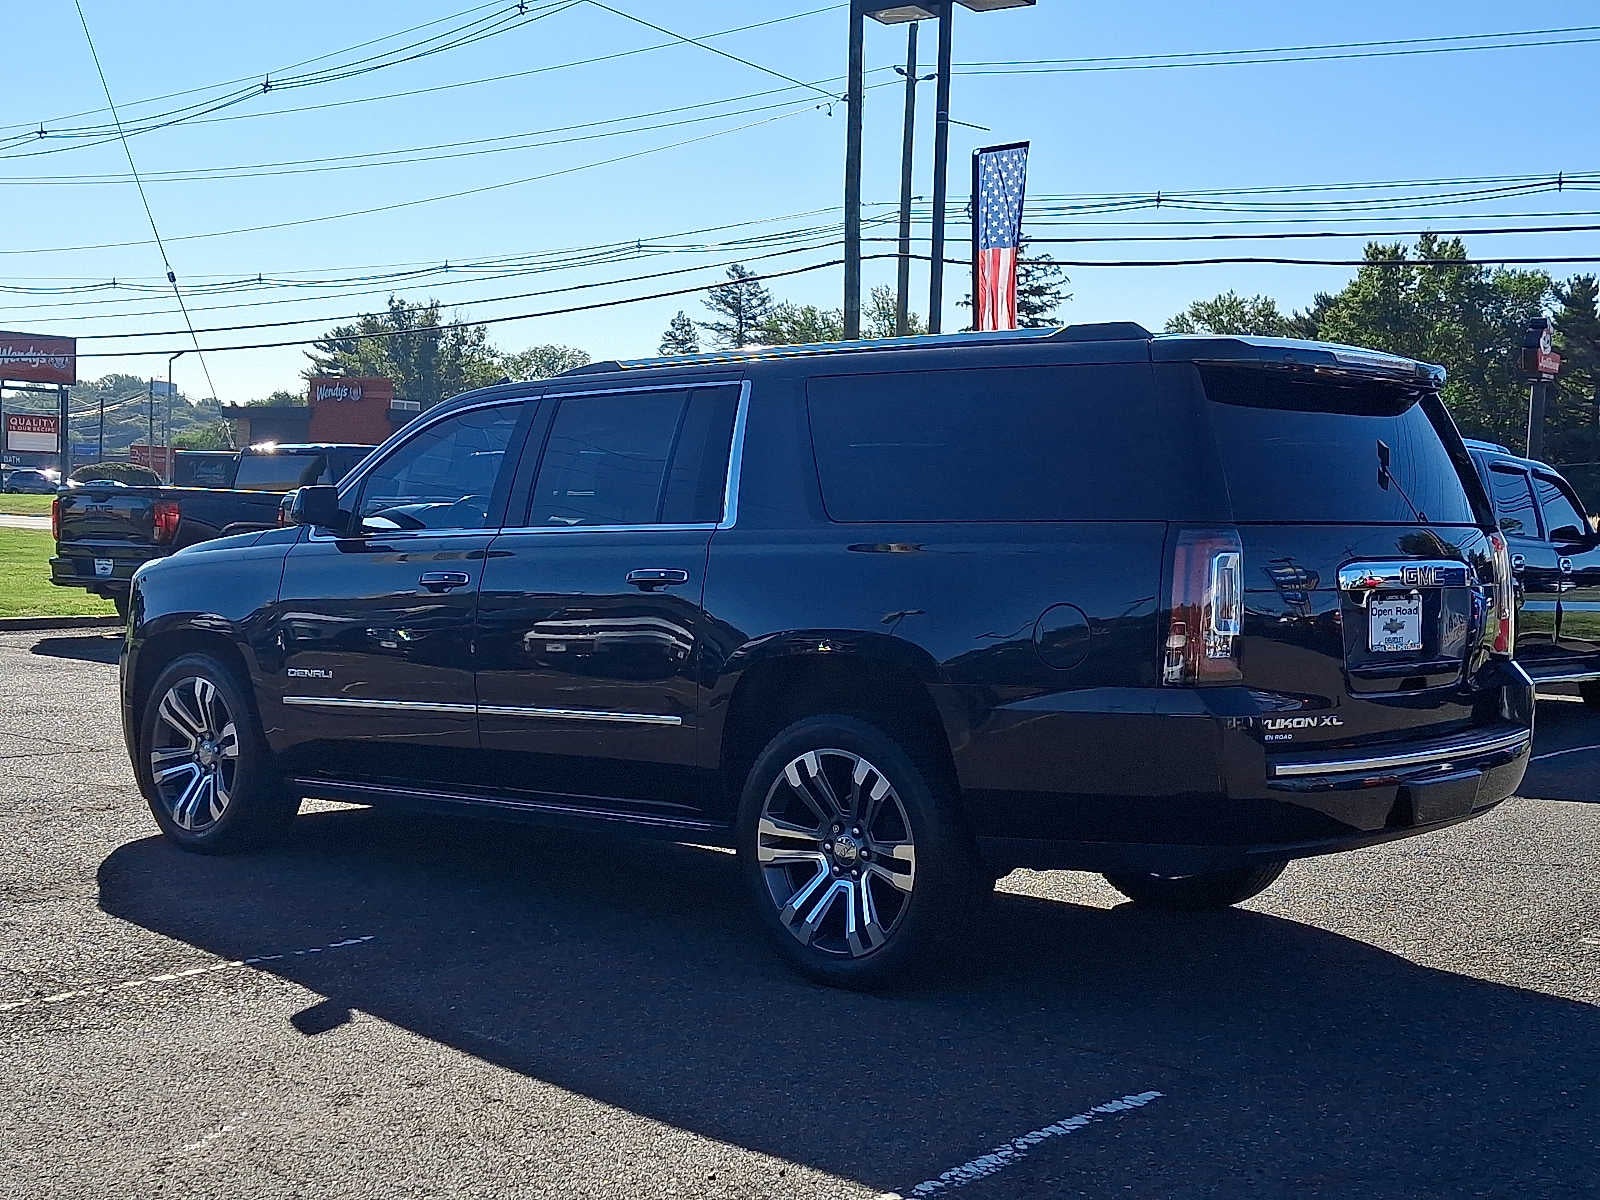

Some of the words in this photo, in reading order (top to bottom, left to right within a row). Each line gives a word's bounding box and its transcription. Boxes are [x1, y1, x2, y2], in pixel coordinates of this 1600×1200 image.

[316, 381, 349, 401] Wendy's
[9, 417, 55, 428] QUALITY
[1402, 566, 1446, 587] GMC
[1371, 606, 1393, 619] Open
[1395, 605, 1419, 616] Road
[287, 668, 333, 679] DENALI
[1319, 715, 1344, 727] XL
